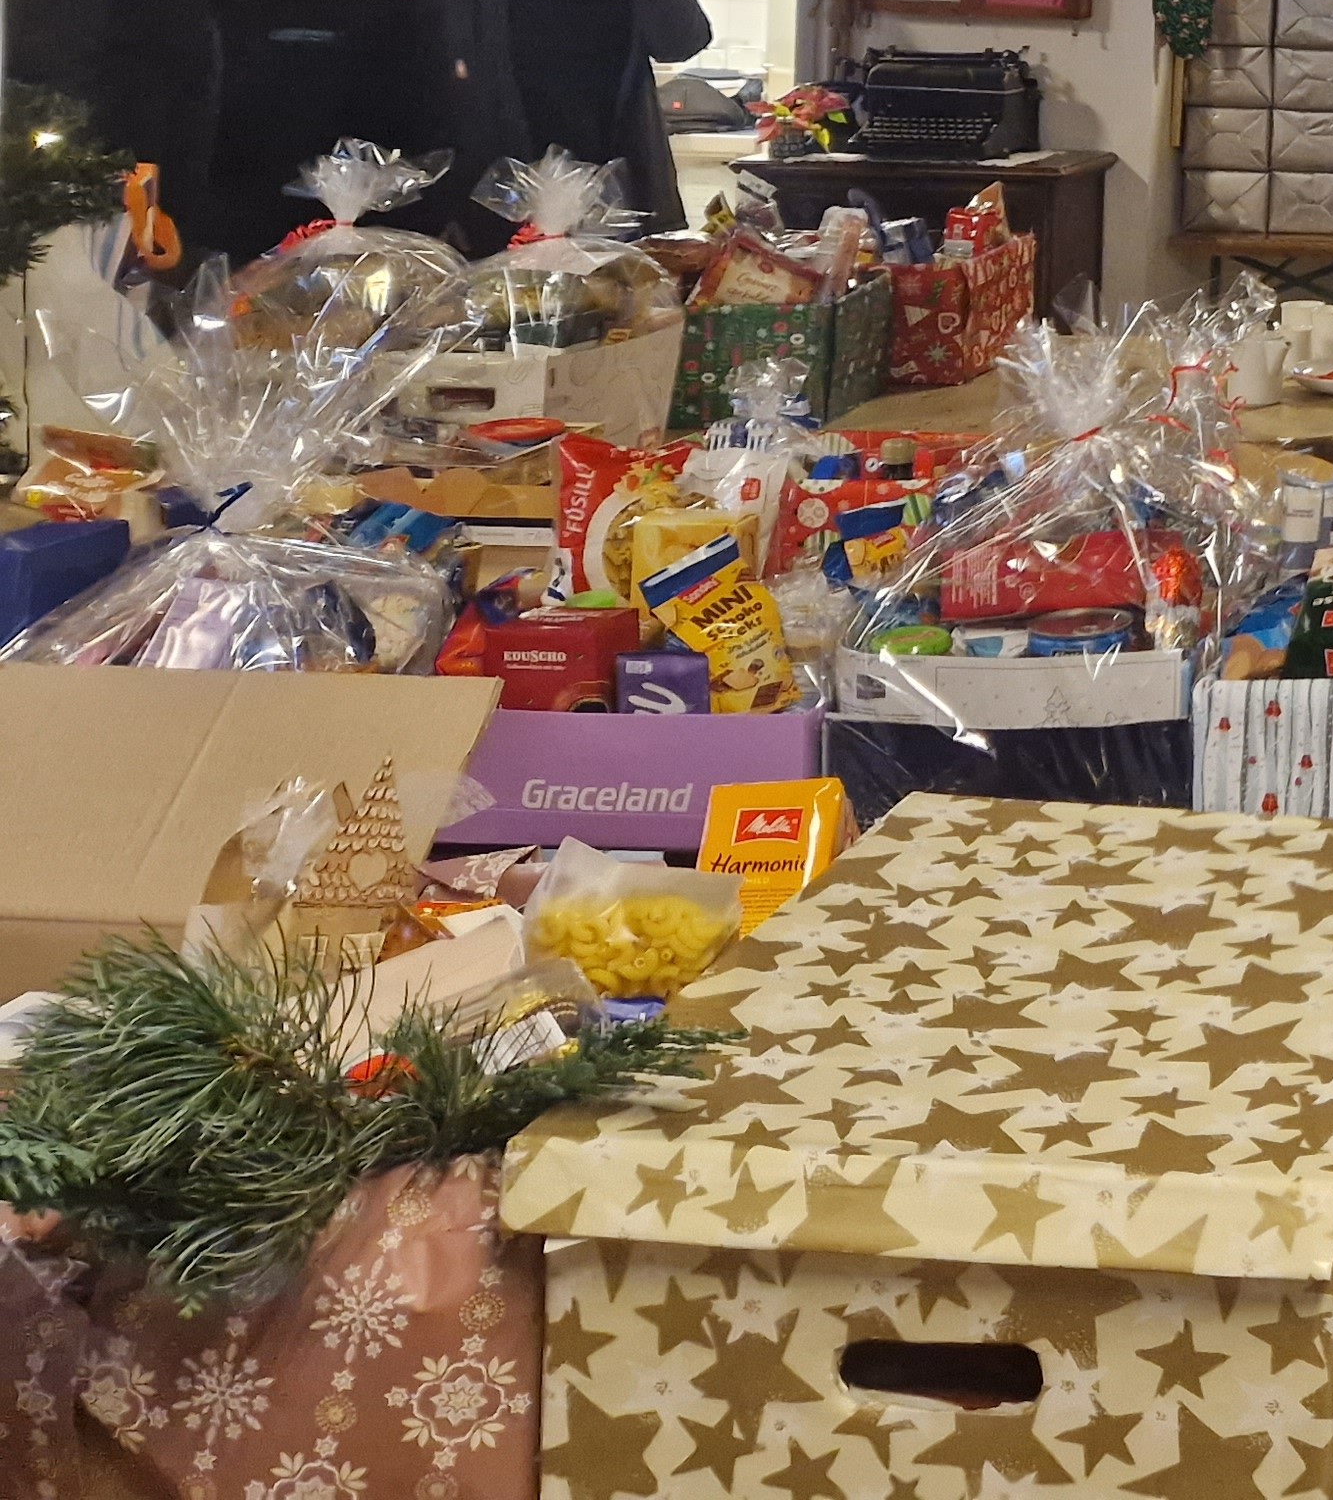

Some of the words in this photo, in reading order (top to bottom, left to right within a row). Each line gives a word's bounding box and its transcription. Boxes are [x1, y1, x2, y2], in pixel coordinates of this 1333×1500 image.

[690, 584, 753, 630] MINI
[503, 651, 568, 663] EDUSCHO
[521, 778, 693, 813] Graceland
